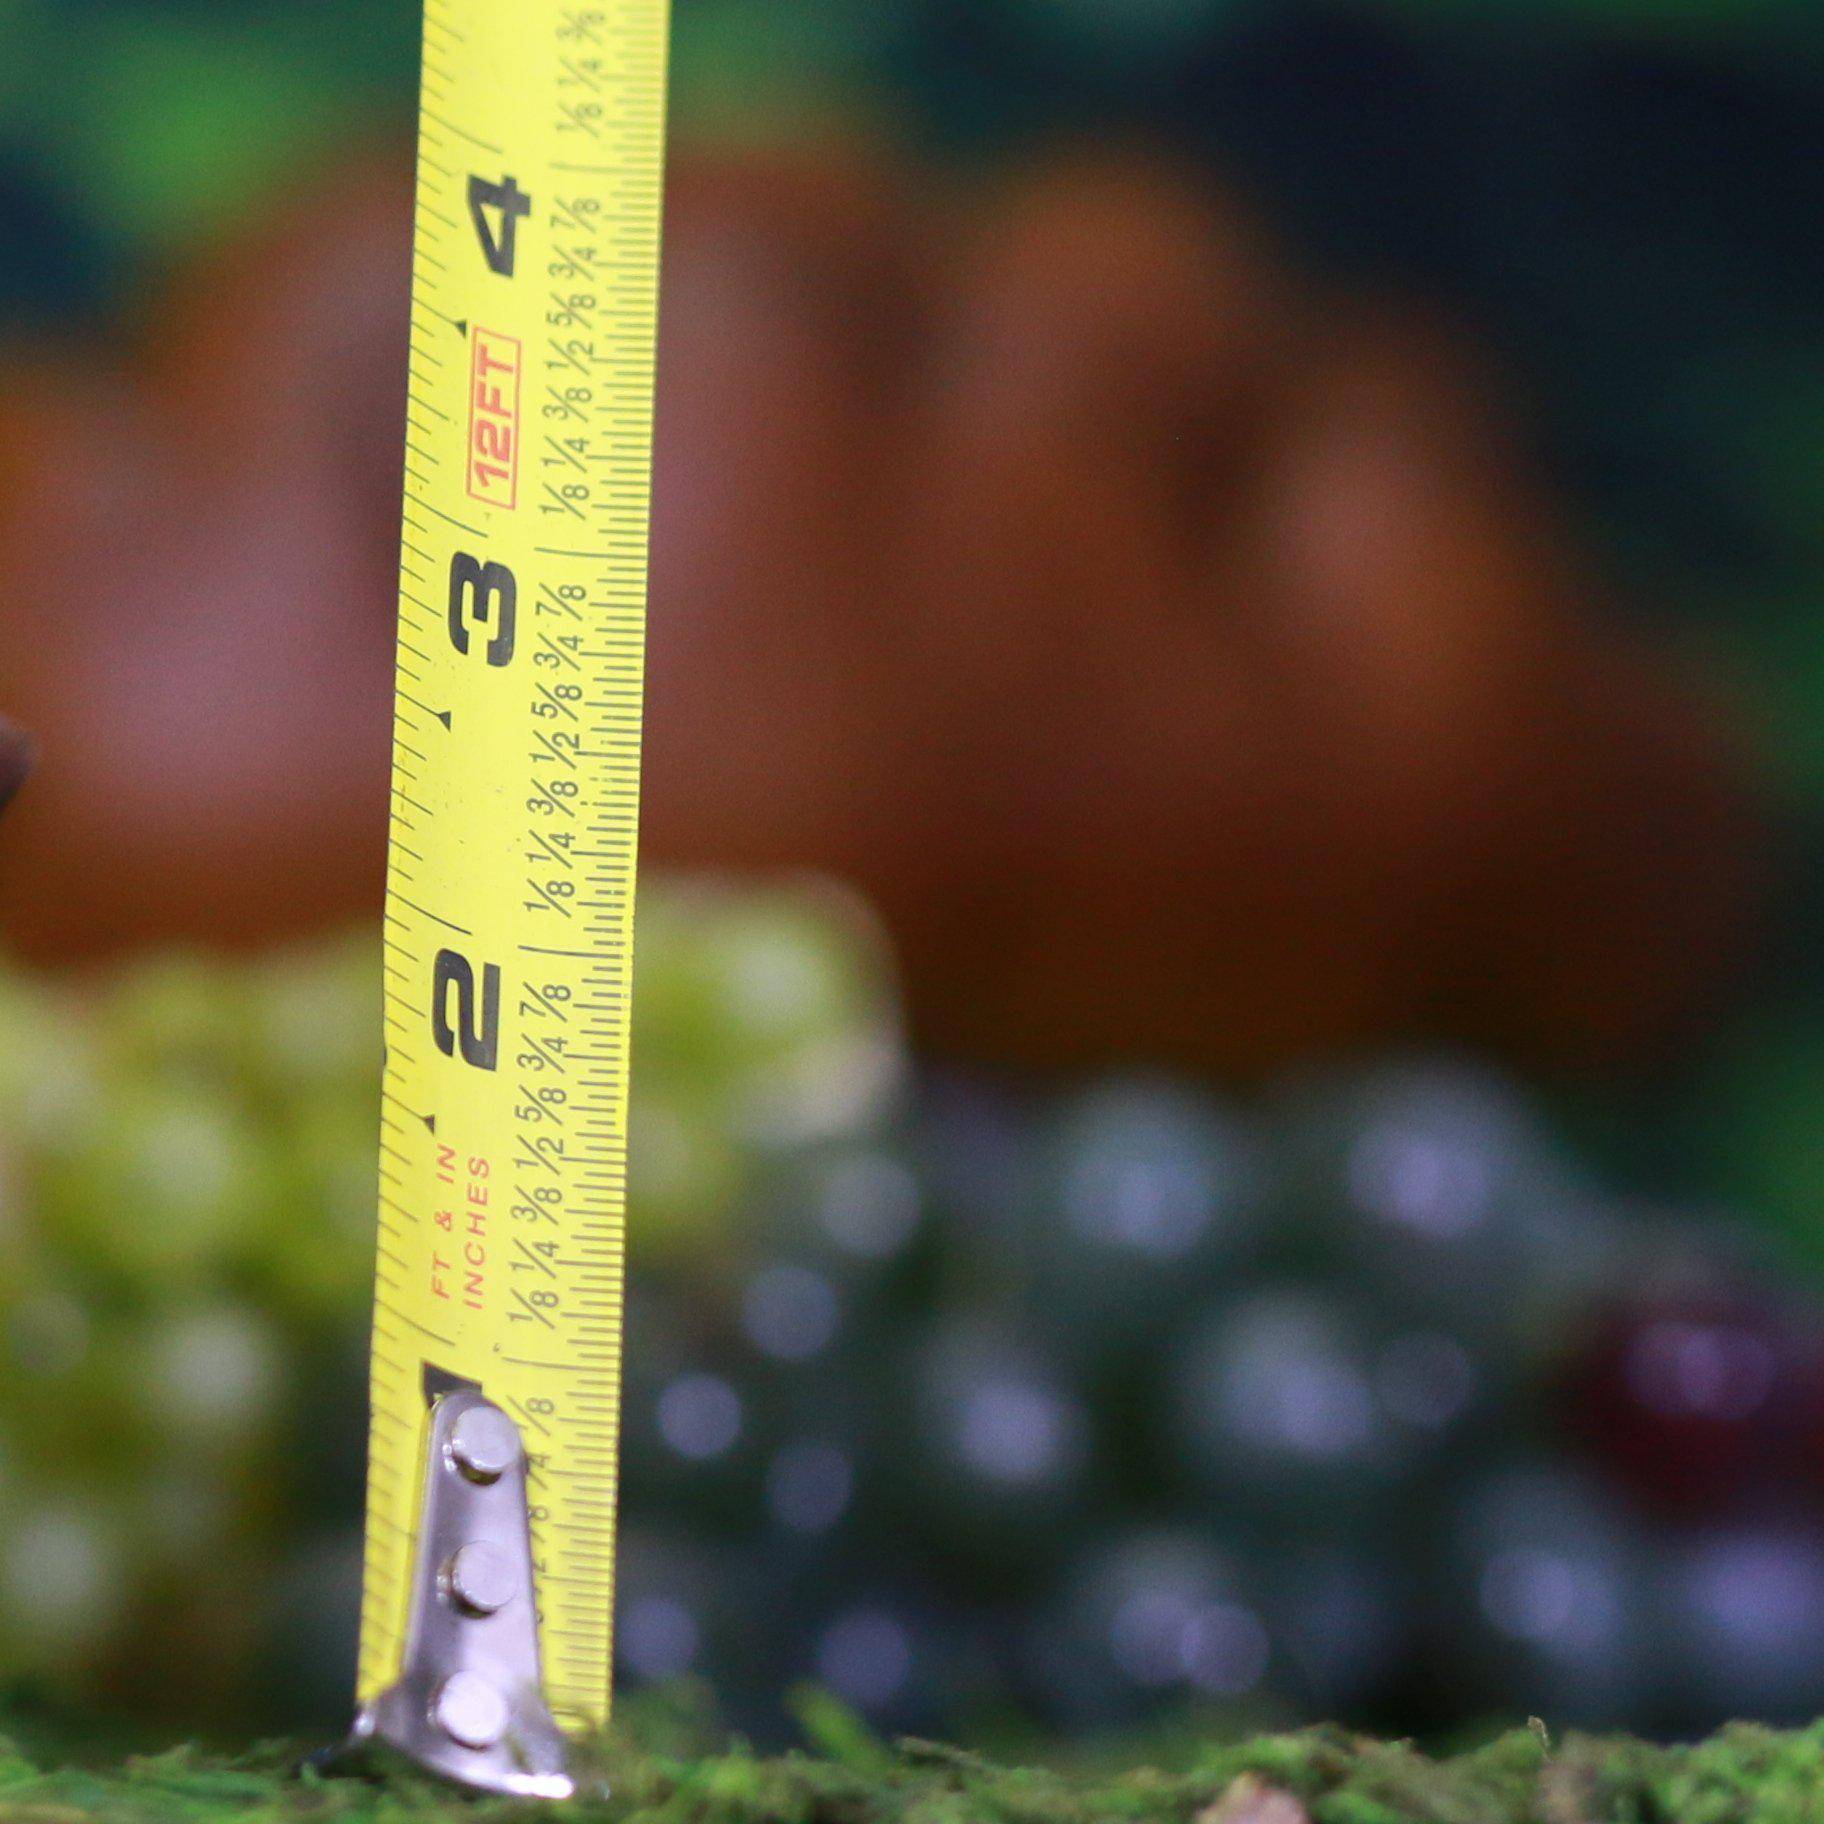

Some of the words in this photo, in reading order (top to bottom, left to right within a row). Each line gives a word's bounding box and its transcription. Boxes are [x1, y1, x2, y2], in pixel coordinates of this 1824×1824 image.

[465, 171, 531, 278] 4
[544, 338, 594, 374] 1/2
[472, 344, 514, 486] 12FT
[542, 384, 592, 422] 3/8
[540, 434, 590, 472] 1/4
[538, 482, 589, 520] 1/8
[448, 550, 516, 666] 3
[536, 582, 586, 620] 7/8
[533, 631, 583, 670] 3/4
[531, 682, 582, 721] 5/8
[528, 728, 580, 769] 1/2
[526, 777, 578, 817] 3/8
[524, 828, 576, 869] 1/4
[522, 877, 574, 918] 1/8
[431, 948, 500, 1071] 2
[519, 980, 571, 1021] 7/8
[516, 1032, 568, 1073] 3/4
[514, 1084, 566, 1124] 5/8
[436, 1142, 455, 1183] IN
[512, 1134, 564, 1174] 1/2
[434, 1210, 452, 1231] &
[510, 1184, 562, 1224] 3/8
[462, 1154, 490, 1309] INCHES
[431, 1250, 450, 1298] FT
[507, 1237, 559, 1278] 1/4
[506, 1286, 558, 1329] 1/8
